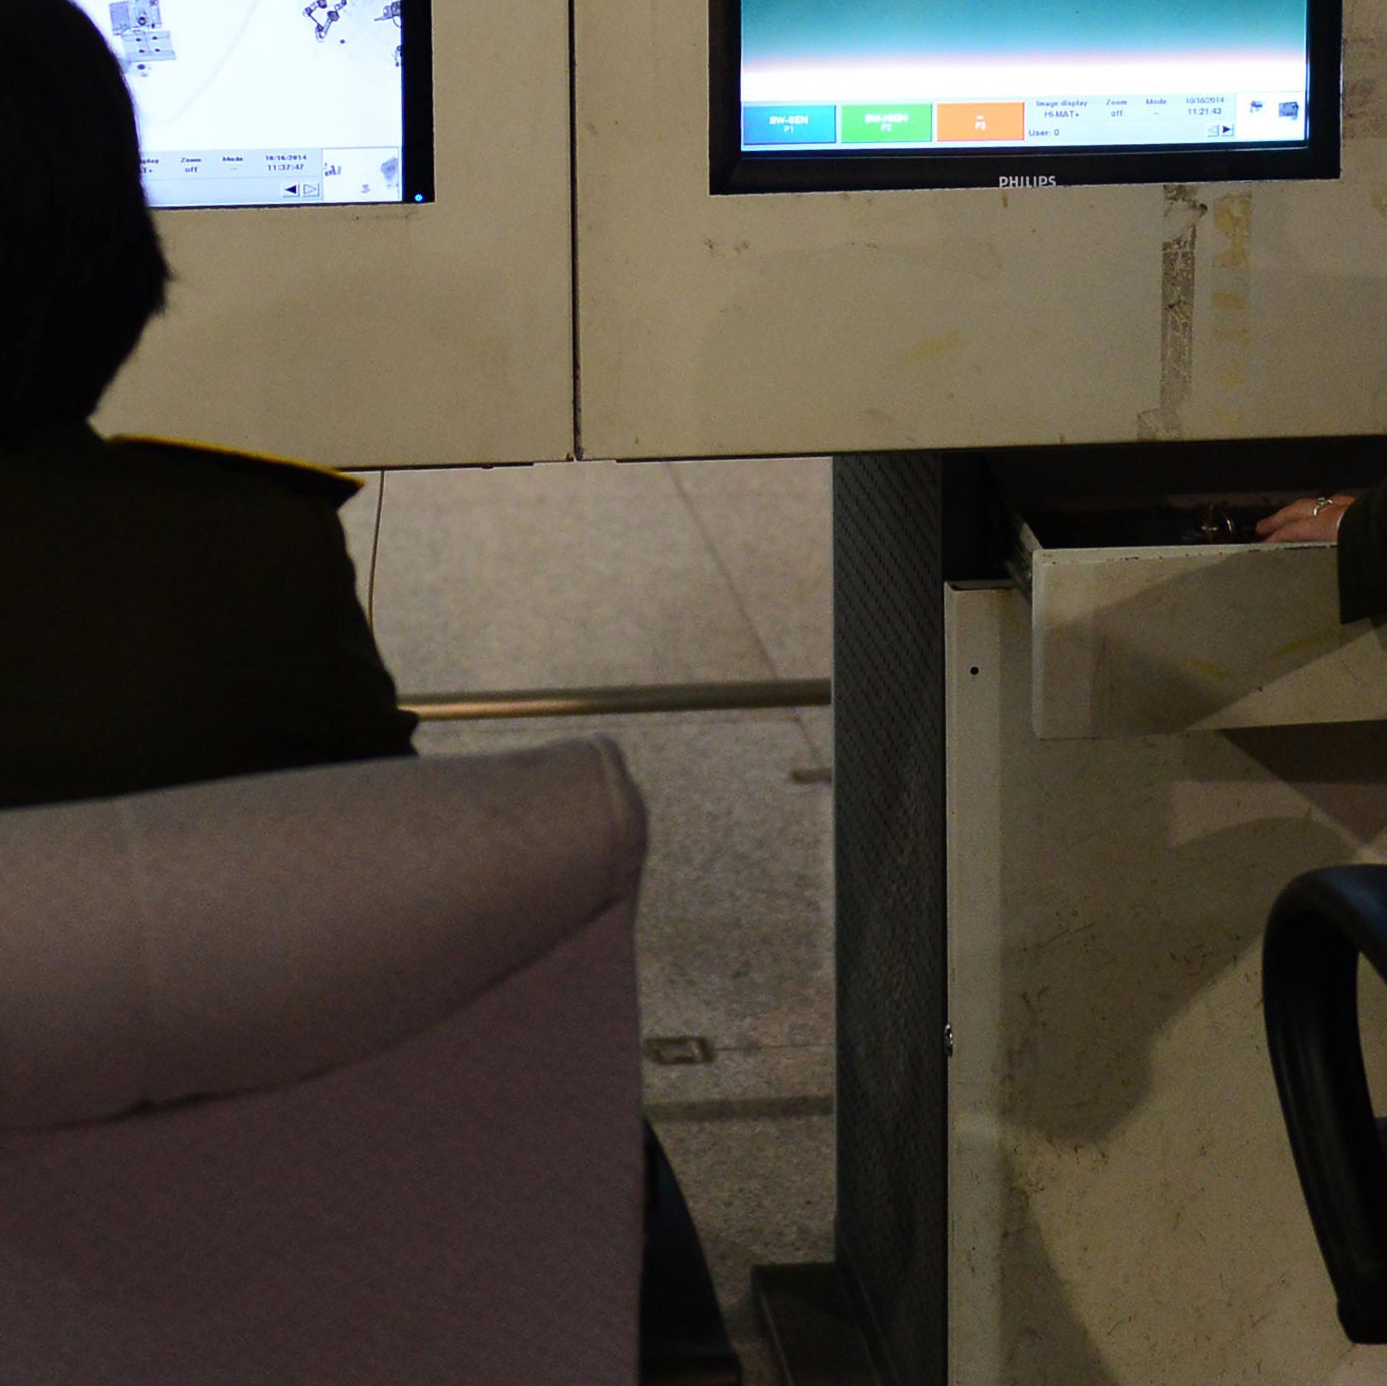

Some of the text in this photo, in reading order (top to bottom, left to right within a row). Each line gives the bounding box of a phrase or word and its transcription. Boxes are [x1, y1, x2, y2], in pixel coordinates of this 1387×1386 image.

[1036, 99, 1088, 108] Image display
[1029, 129, 1051, 137] User:
[999, 175, 1057, 188] PHILIPS
